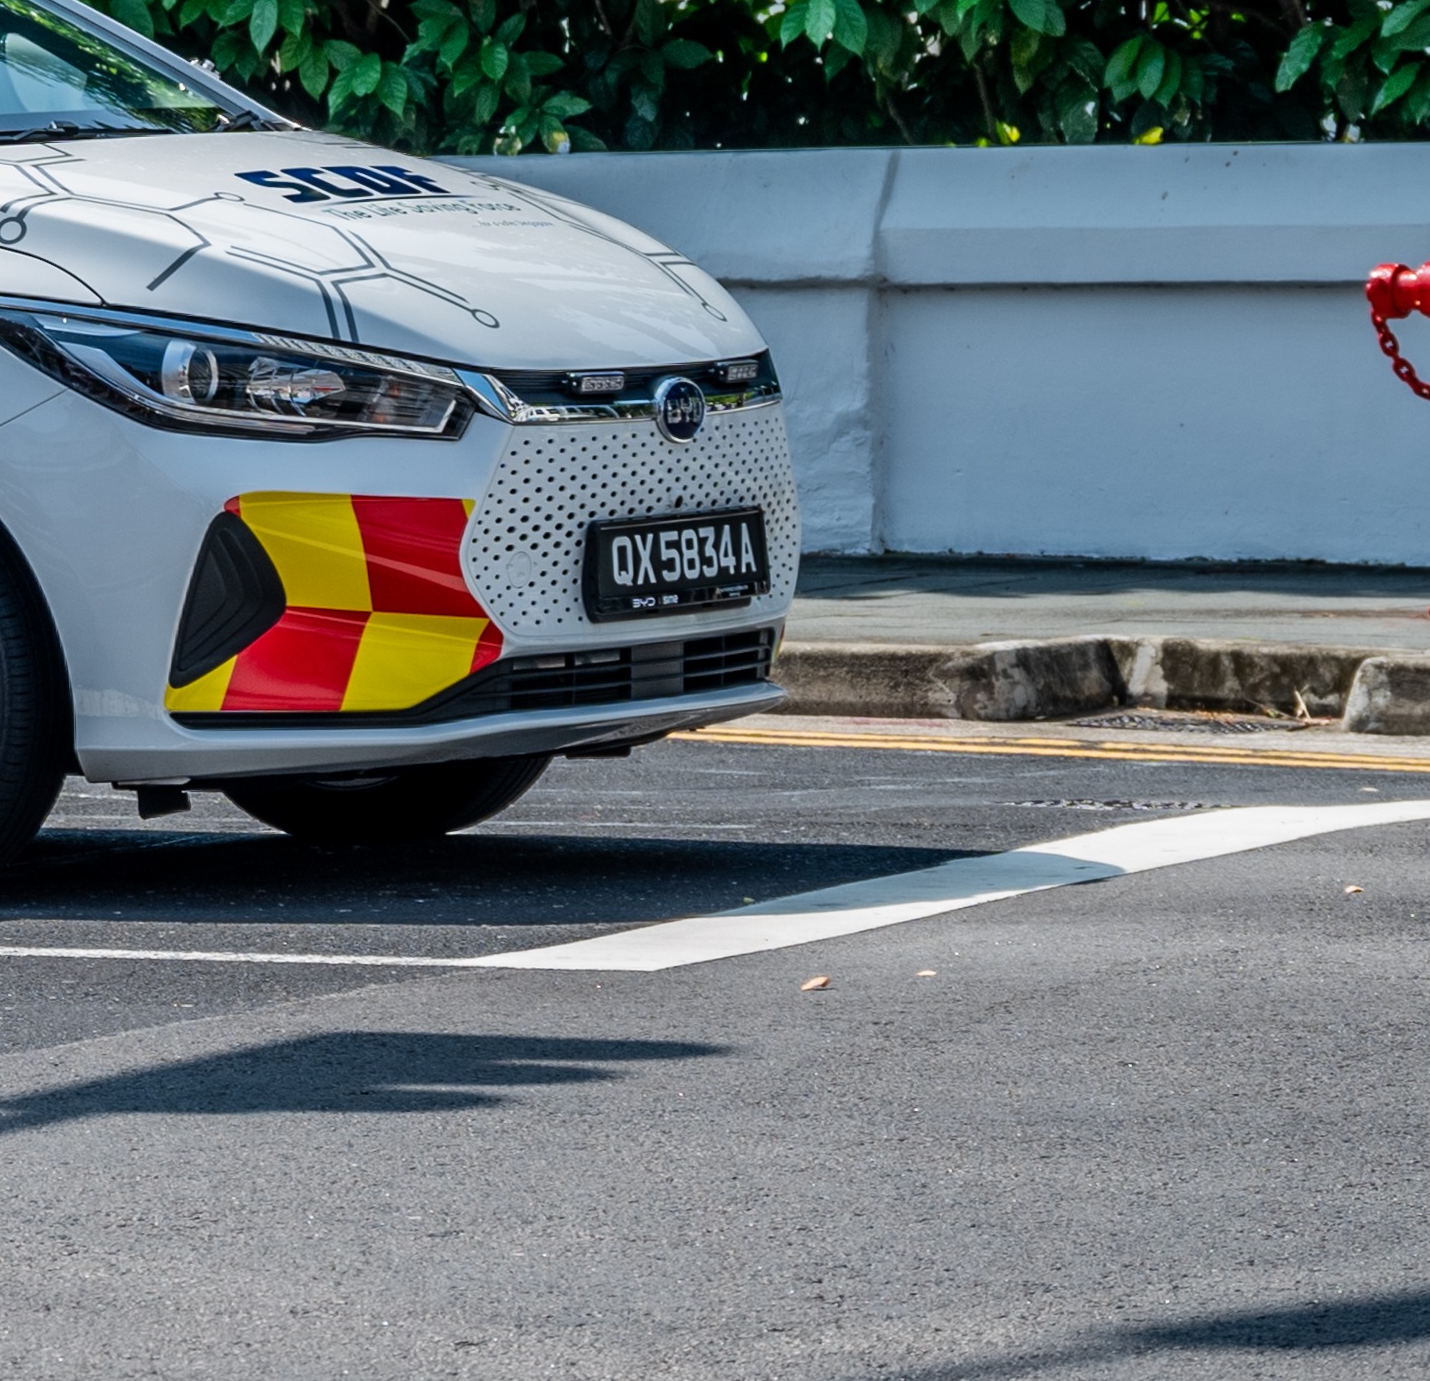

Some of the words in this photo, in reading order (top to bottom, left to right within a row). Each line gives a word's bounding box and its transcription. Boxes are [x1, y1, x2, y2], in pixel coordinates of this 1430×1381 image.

[234, 165, 451, 203] SCDF
[666, 396, 702, 424] BYD
[612, 522, 757, 586] QX5834A
[632, 597, 656, 608] BYD
